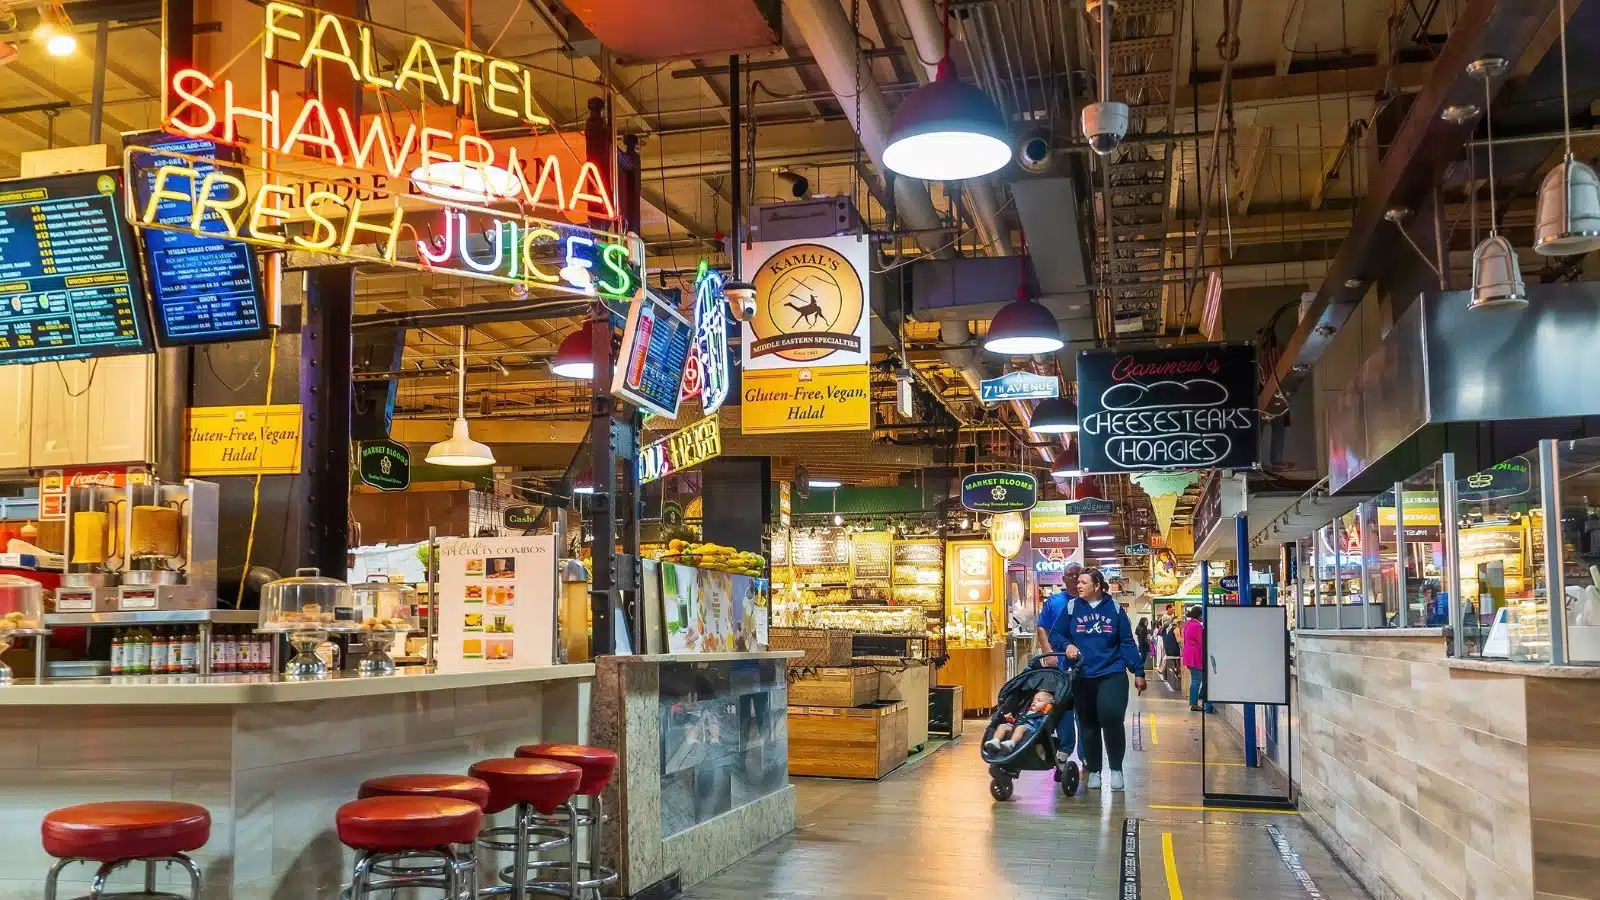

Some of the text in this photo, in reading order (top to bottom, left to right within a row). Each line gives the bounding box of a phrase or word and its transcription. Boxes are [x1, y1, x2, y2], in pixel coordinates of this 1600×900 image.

[264, 2, 550, 126] FALAFEL
[171, 68, 615, 219] SHAWERMA
[144, 164, 632, 297] FRESH JUICES
[205, 244, 225, 252] COMBO
[769, 253, 840, 275] KAMAL'S
[752, 336, 859, 354] MIDDLE EASTERN SPECIALTIES
[745, 385, 868, 403] Gluten-Free, Vegan,
[1006, 382, 1054, 393] AVENUE
[787, 404, 826, 420] Halal
[1082, 407, 1252, 435] CHEESESTEAKS
[260, 426, 300, 445] Vegan,
[221, 446, 259, 462] Halal
[362, 446, 409, 467] MARKET BLOOMS
[1120, 439, 1217, 463] HOAGIES
[965, 478, 1034, 491] MARKET BLOOMS
[1082, 503, 1112, 511] AVENUE
[441, 546, 492, 556] SPECIALTY
[496, 544, 546, 555] COMBOS
